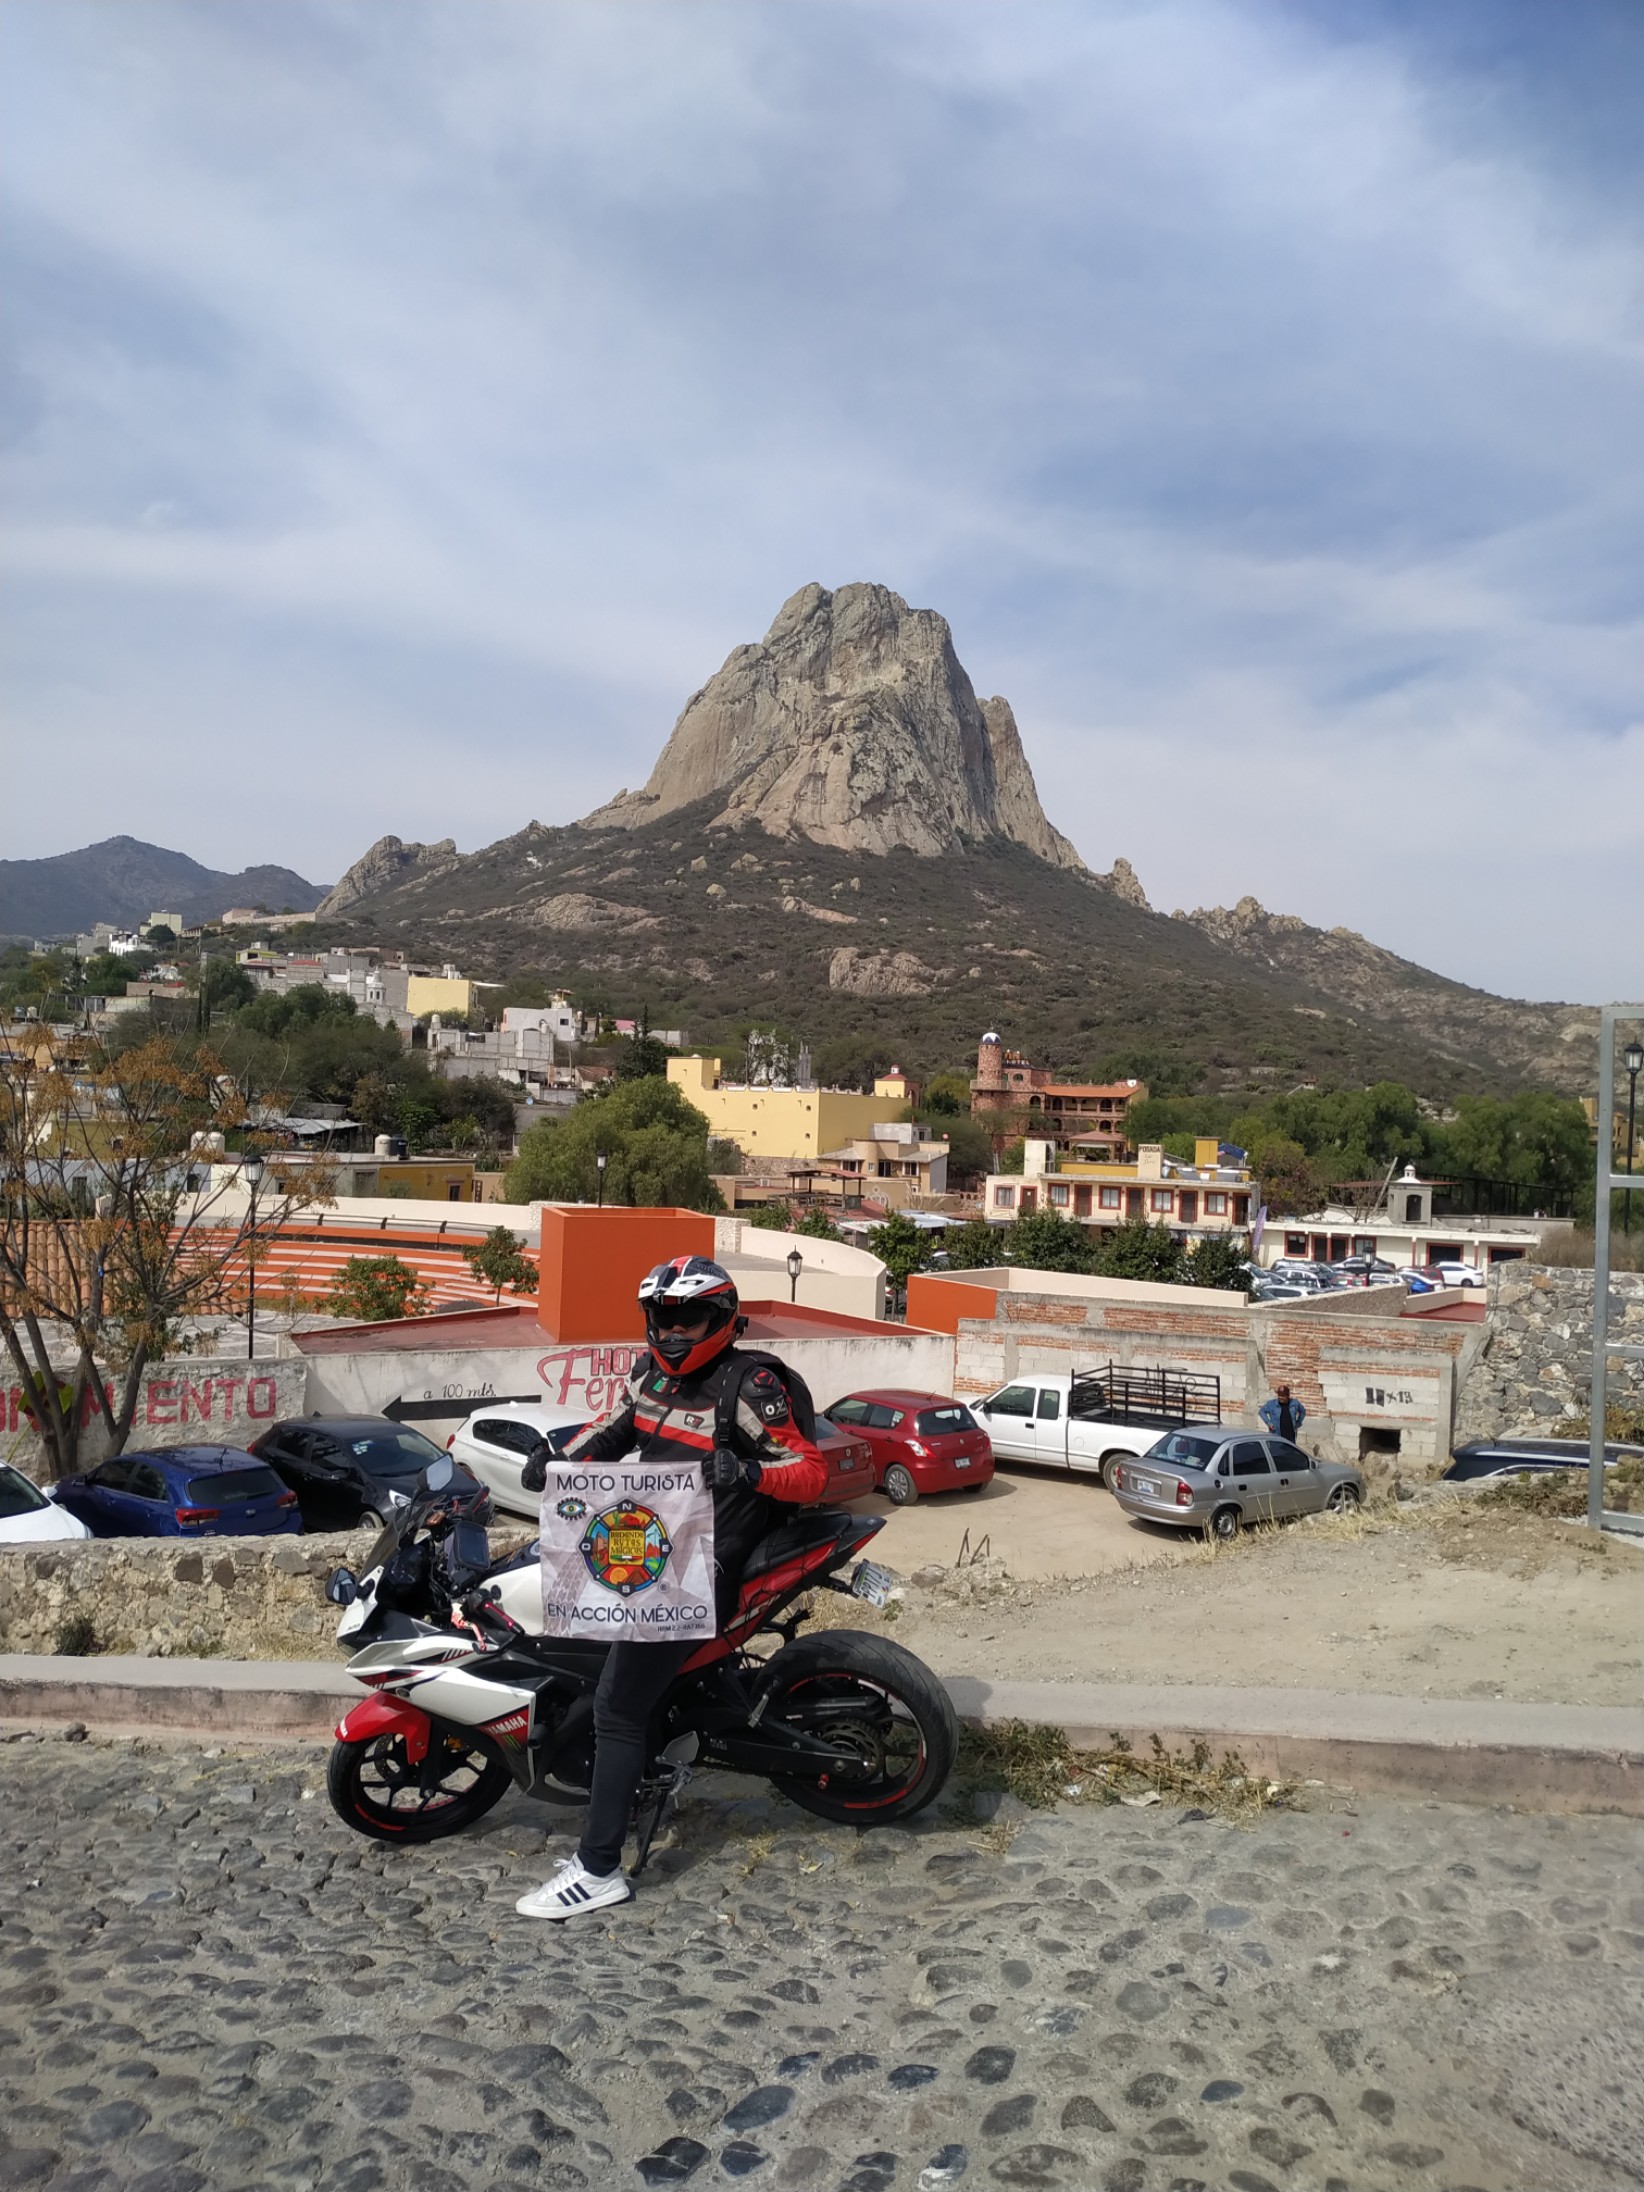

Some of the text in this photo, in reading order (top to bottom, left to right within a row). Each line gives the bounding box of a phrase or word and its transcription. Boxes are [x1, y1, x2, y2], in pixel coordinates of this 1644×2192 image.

[423, 1389, 433, 1399] a
[442, 1384, 463, 1398] 100
[557, 1474, 695, 1491] MOTO TURISTA
[662, 1544, 670, 1552] E
[622, 1584, 631, 1594] S
[548, 1604, 708, 1623] EN ACCIÓN MÉXICO
[484, 1715, 528, 1735] YAMAHA
